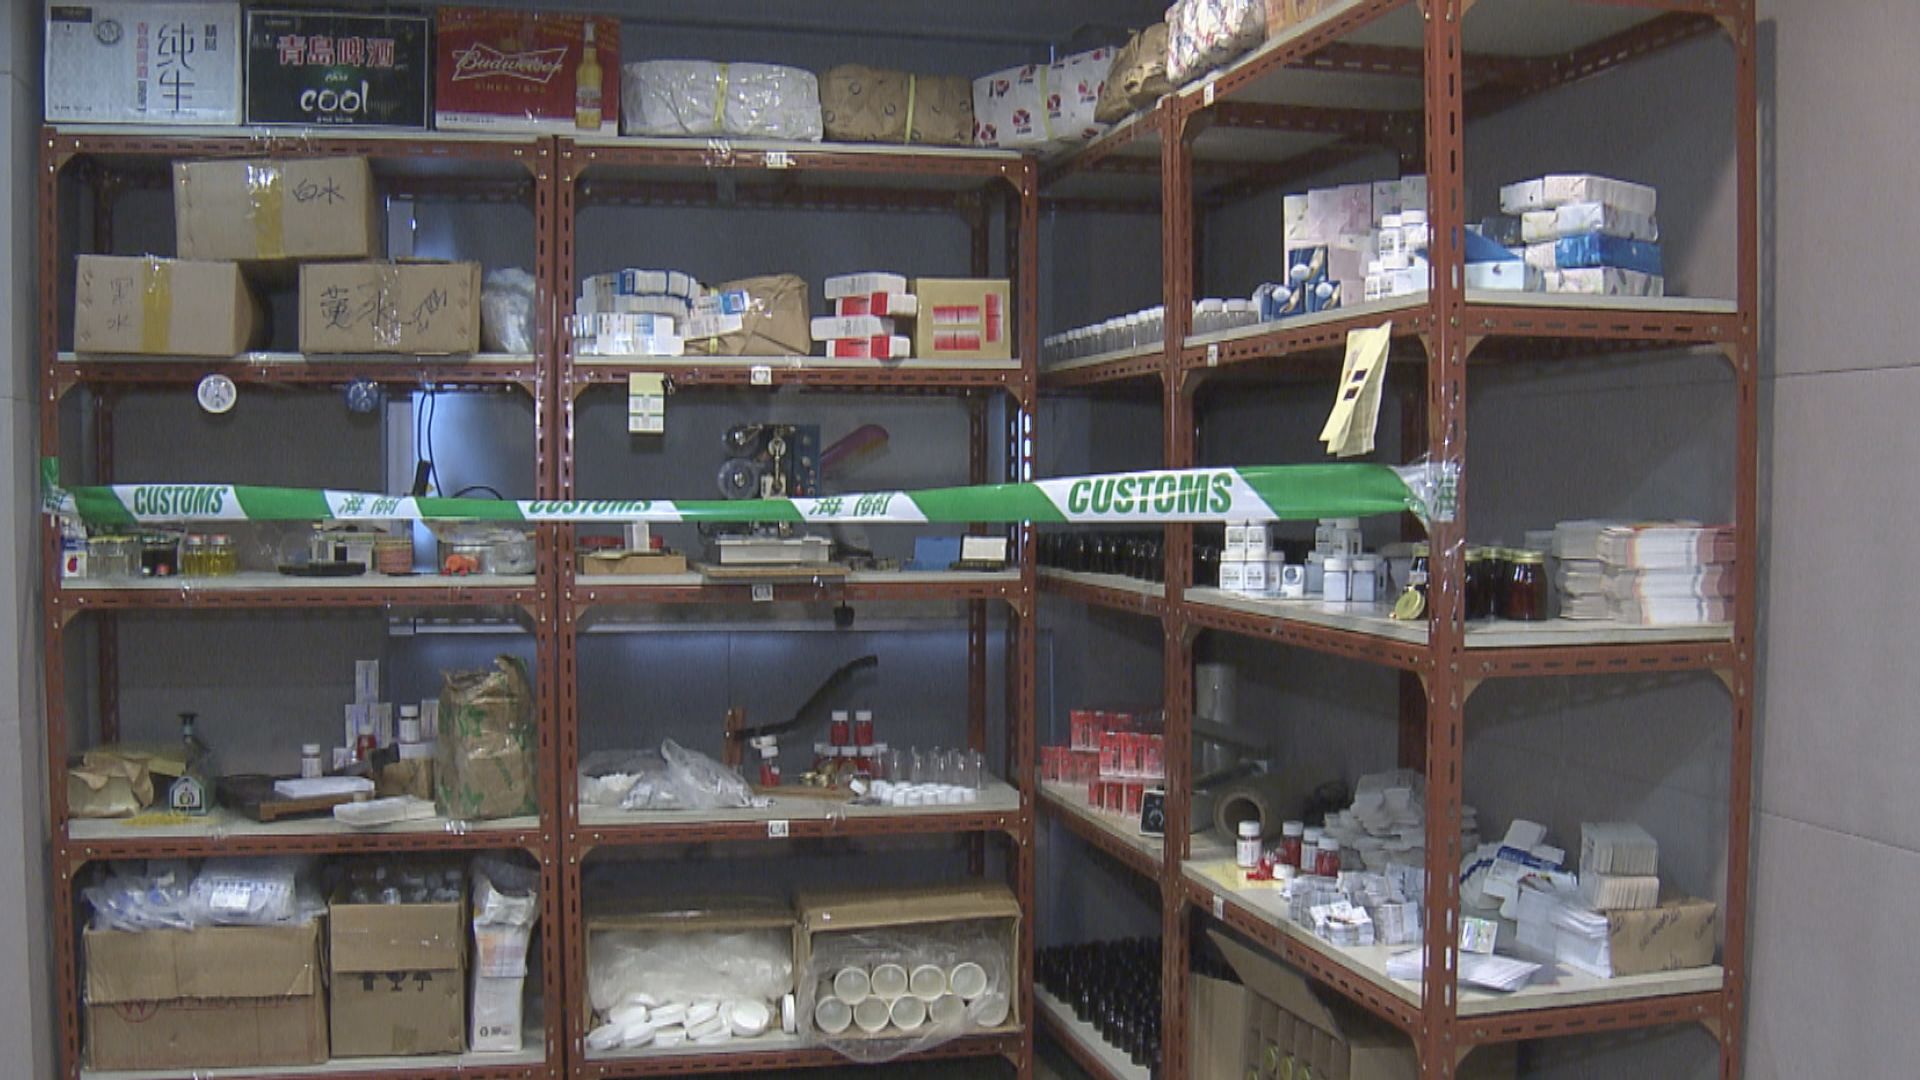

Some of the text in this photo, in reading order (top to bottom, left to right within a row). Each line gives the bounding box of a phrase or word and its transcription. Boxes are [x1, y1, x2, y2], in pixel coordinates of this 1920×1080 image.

[156, 22, 195, 113] 纯生
[453, 50, 564, 73] Budweiser
[134, 486, 228, 515] CUSTOMS
[1067, 472, 1233, 515] CUSTOMS
